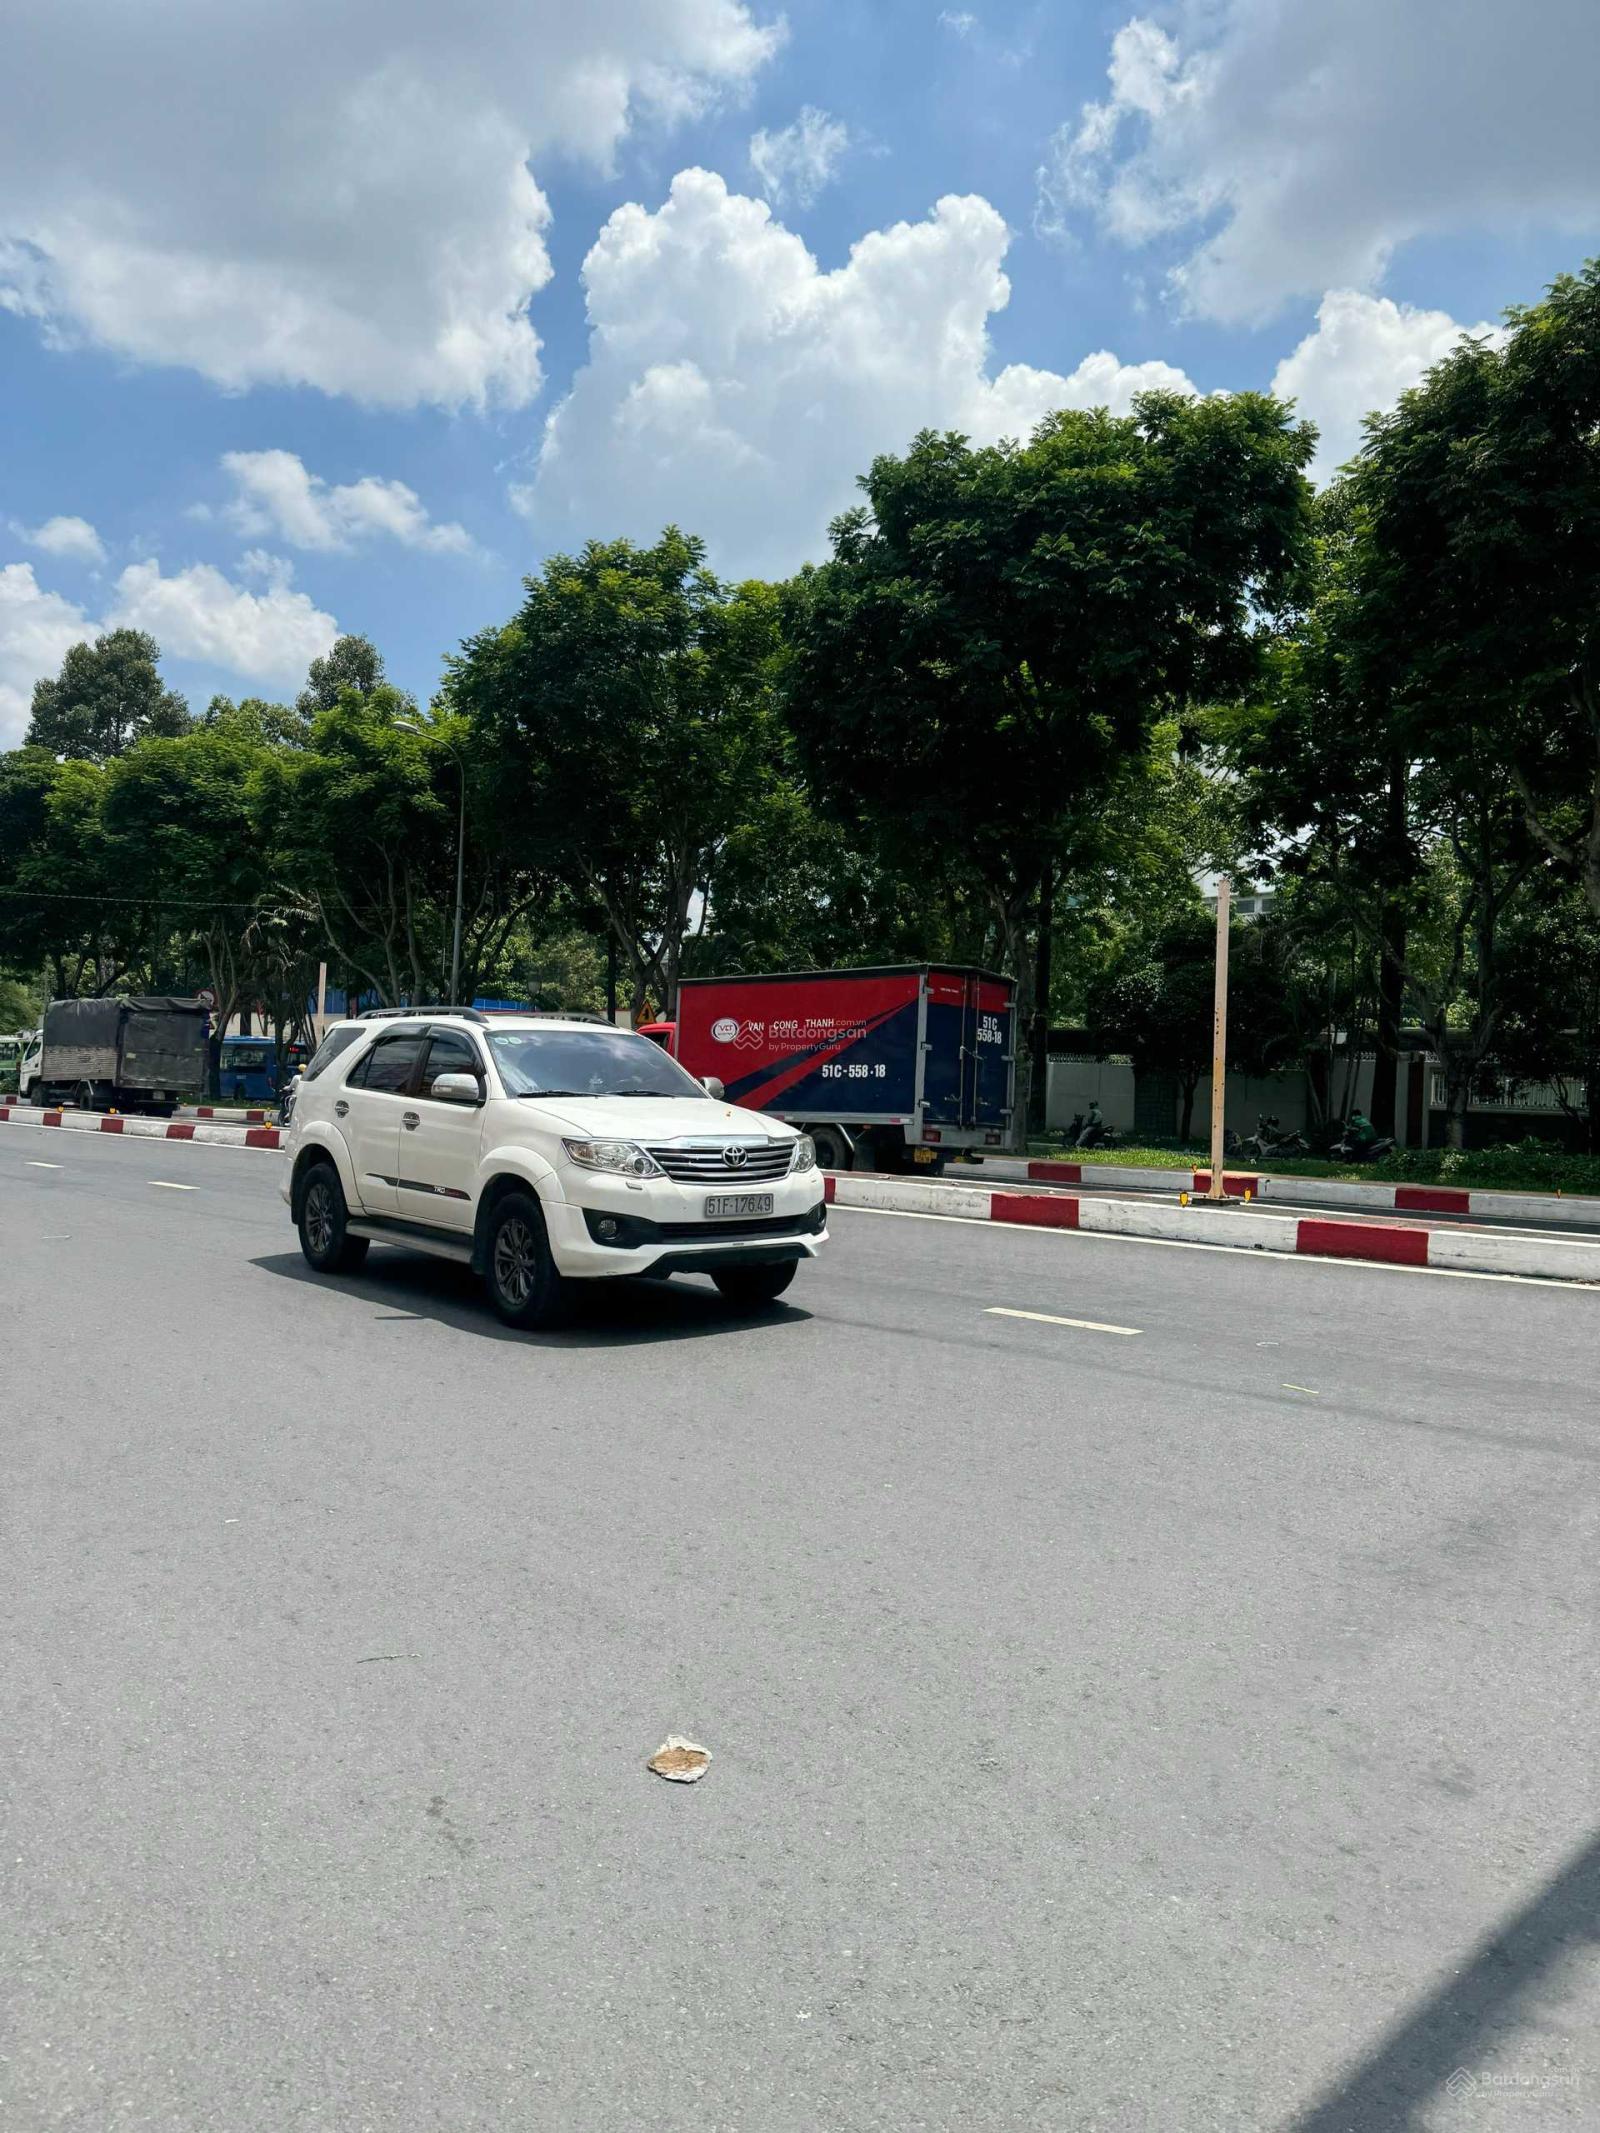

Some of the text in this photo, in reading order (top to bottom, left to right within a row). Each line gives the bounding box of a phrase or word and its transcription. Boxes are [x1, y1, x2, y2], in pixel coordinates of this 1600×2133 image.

[773, 1020, 798, 1030] CONG
[805, 1018, 834, 1029] THANH
[983, 1016, 998, 1031] 51C
